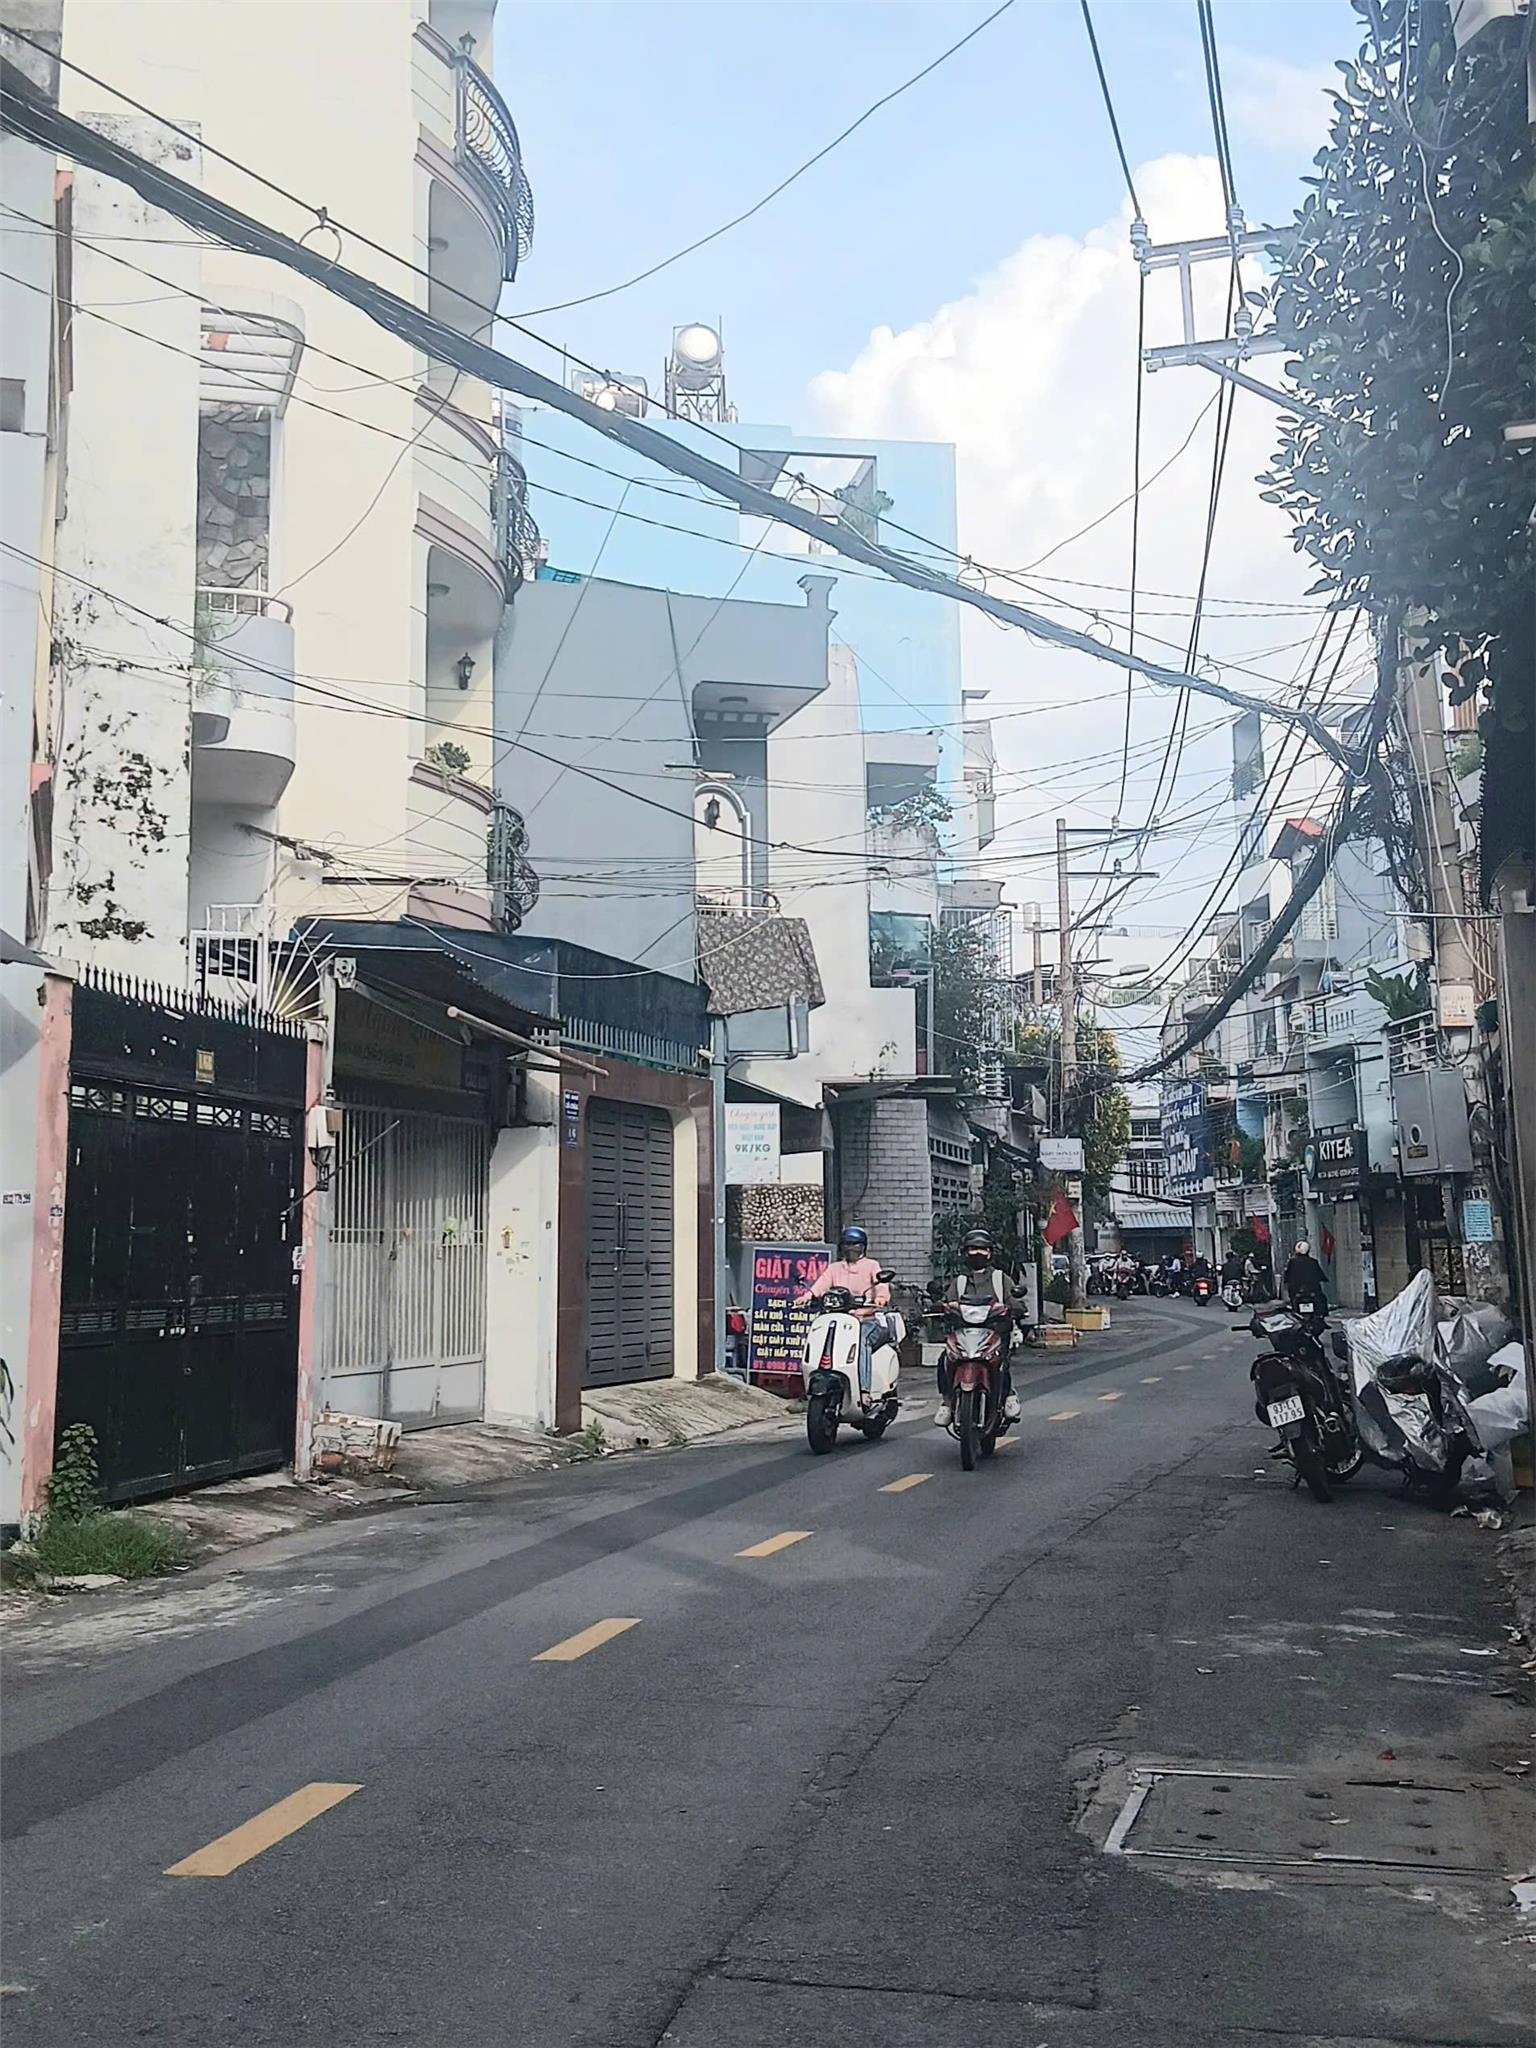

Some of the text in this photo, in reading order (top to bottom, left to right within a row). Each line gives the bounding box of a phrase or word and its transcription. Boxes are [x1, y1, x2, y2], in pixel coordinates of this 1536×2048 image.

[735, 1143, 771, 1153] 9K/KG
[1319, 1136, 1351, 1160] KITEA
[755, 1254, 792, 1283] GIẶT
[755, 1283, 790, 1297] Chuyên
